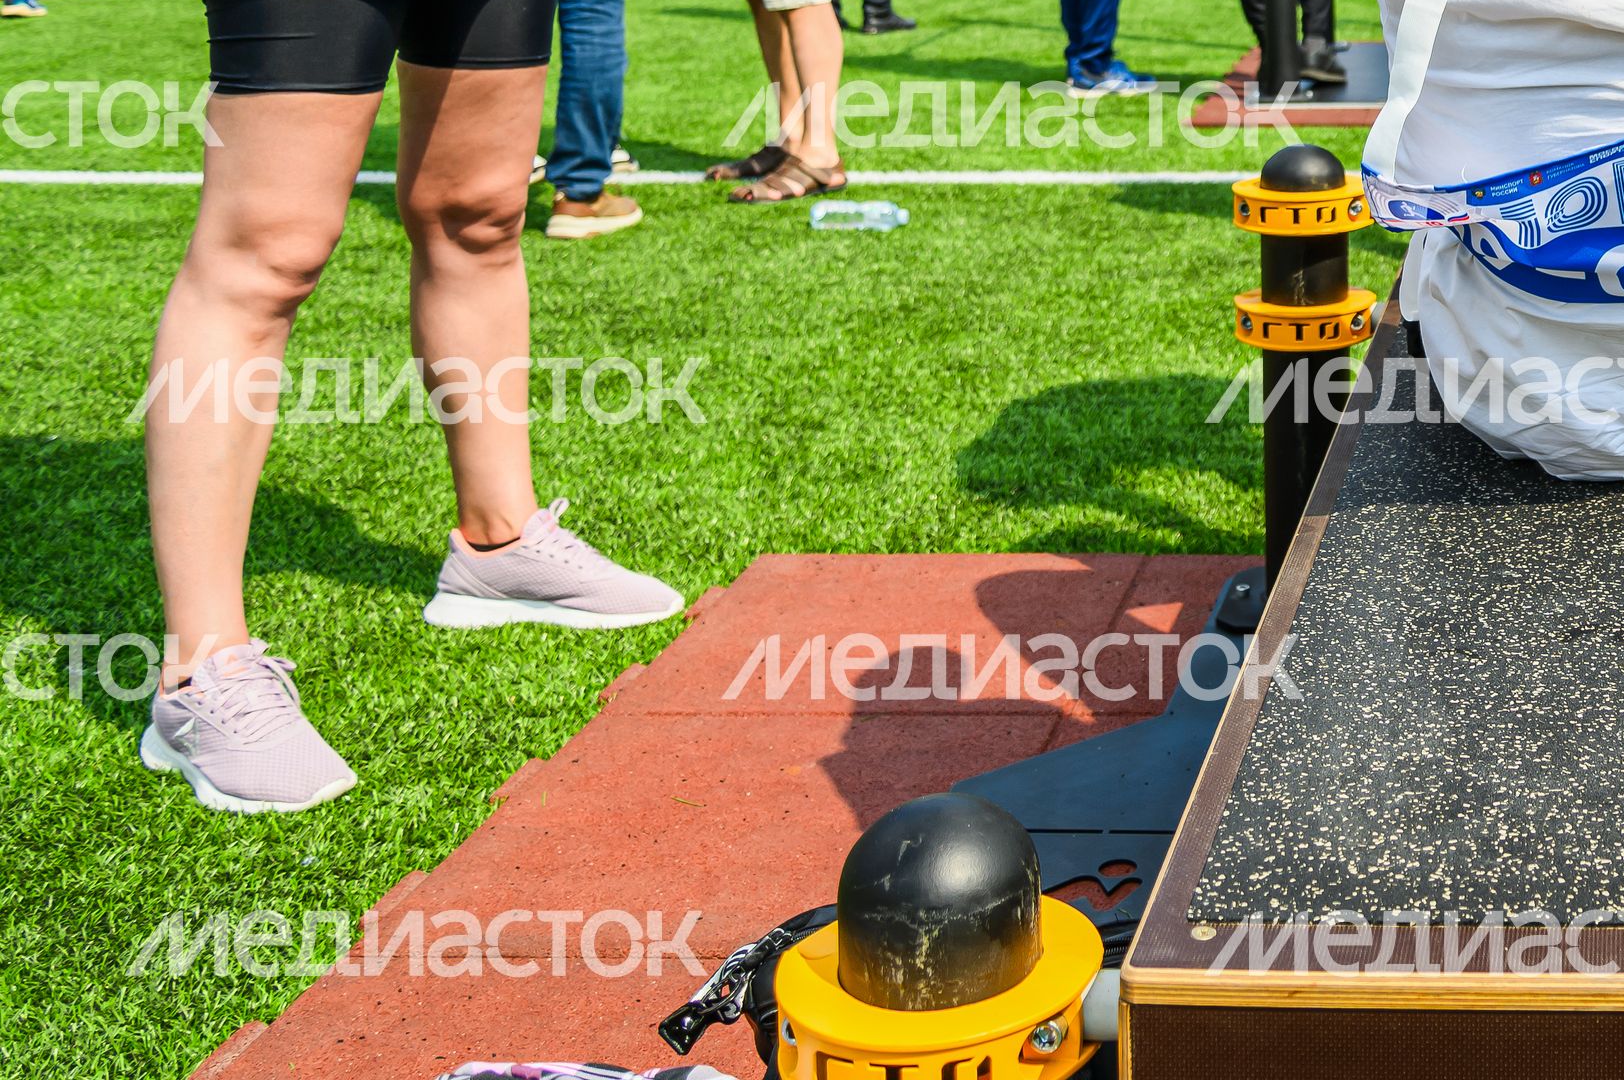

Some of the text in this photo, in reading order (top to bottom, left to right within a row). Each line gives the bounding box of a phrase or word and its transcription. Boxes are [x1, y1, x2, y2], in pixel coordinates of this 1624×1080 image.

[1491, 187, 1518, 198] РОССИИ
[1259, 206, 1337, 225] ГТО
[1262, 321, 1341, 341] ГТО
